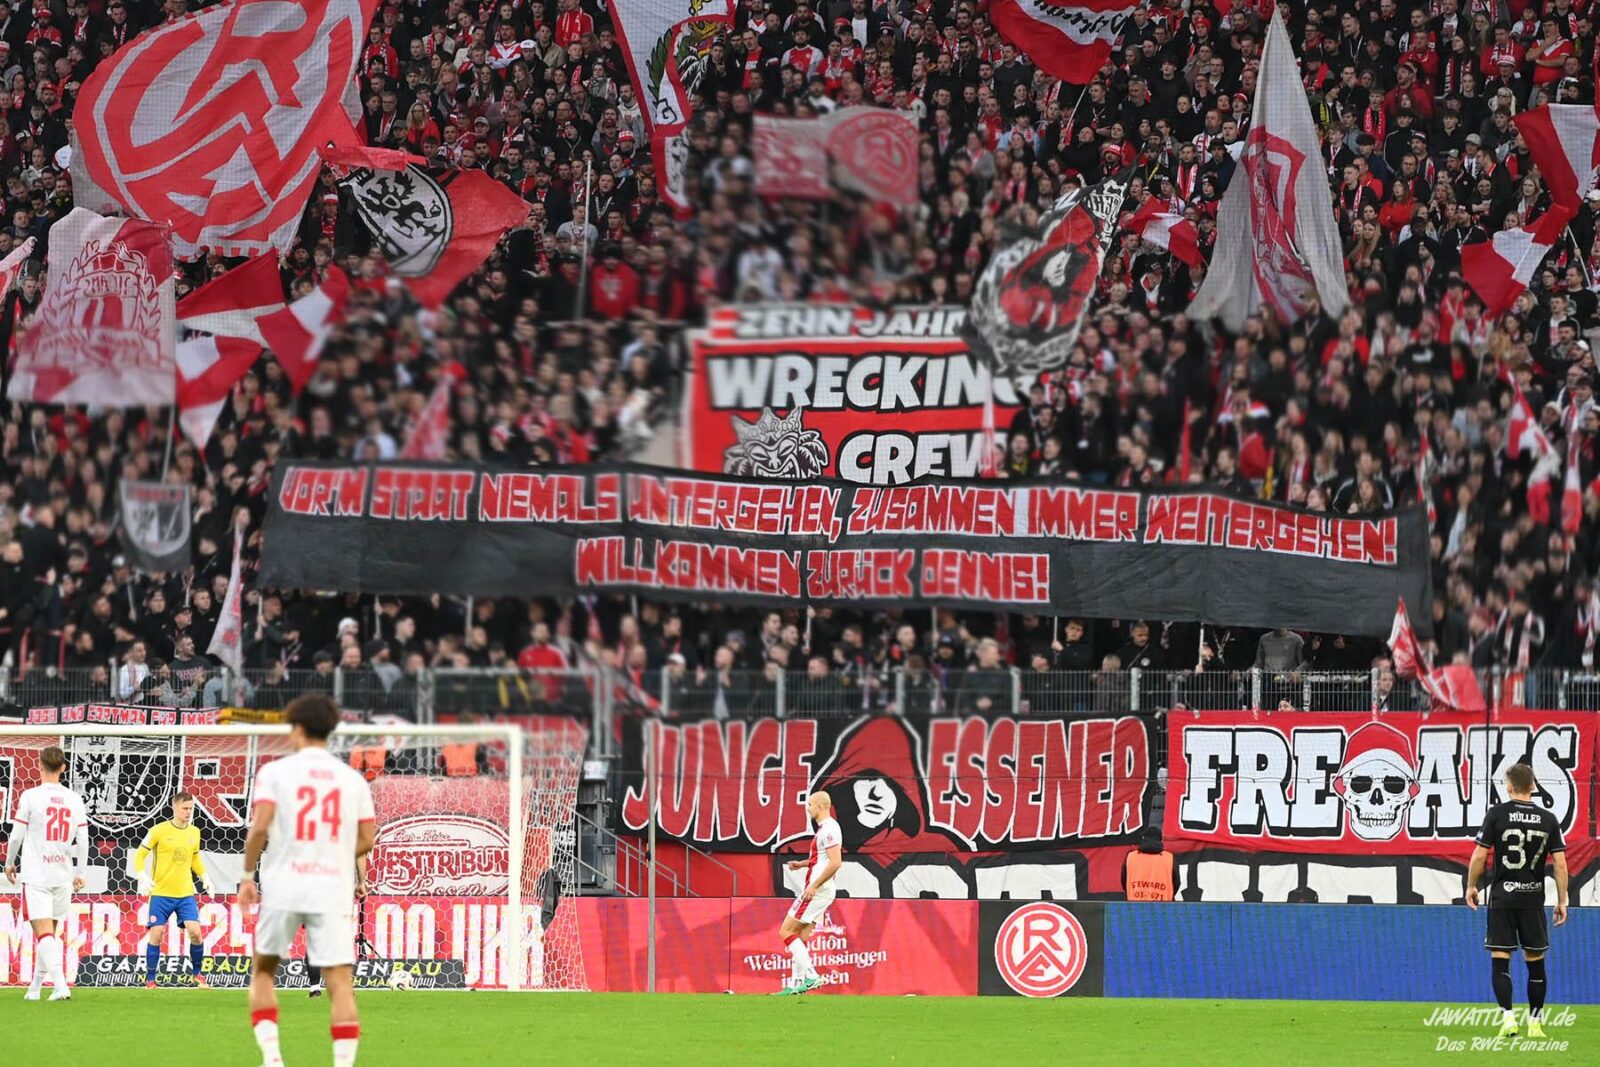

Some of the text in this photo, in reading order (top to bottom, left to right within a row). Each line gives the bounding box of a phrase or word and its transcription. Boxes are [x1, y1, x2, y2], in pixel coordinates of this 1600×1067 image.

[736, 306, 851, 338] ZEHN
[369, 467, 475, 522] STAAT
[478, 472, 623, 524] NIEMALS
[626, 472, 842, 543] UNTERGEHEN,
[847, 485, 1017, 536] ZUSAMMEN
[1026, 486, 1141, 543] IMMER
[1143, 494, 1397, 566] WEITERGEHEN!
[575, 536, 1050, 603] WILLKOMMEN ZURÜCK DENNIS!
[622, 717, 818, 849] JUNGE
[927, 716, 1149, 847] ESSENER
[46, 806, 71, 842] 26
[296, 785, 341, 842] 24
[1509, 811, 1541, 823] MÜLLER
[366, 848, 508, 886] WESTTRIBÜN
[1502, 828, 1550, 870] 37
